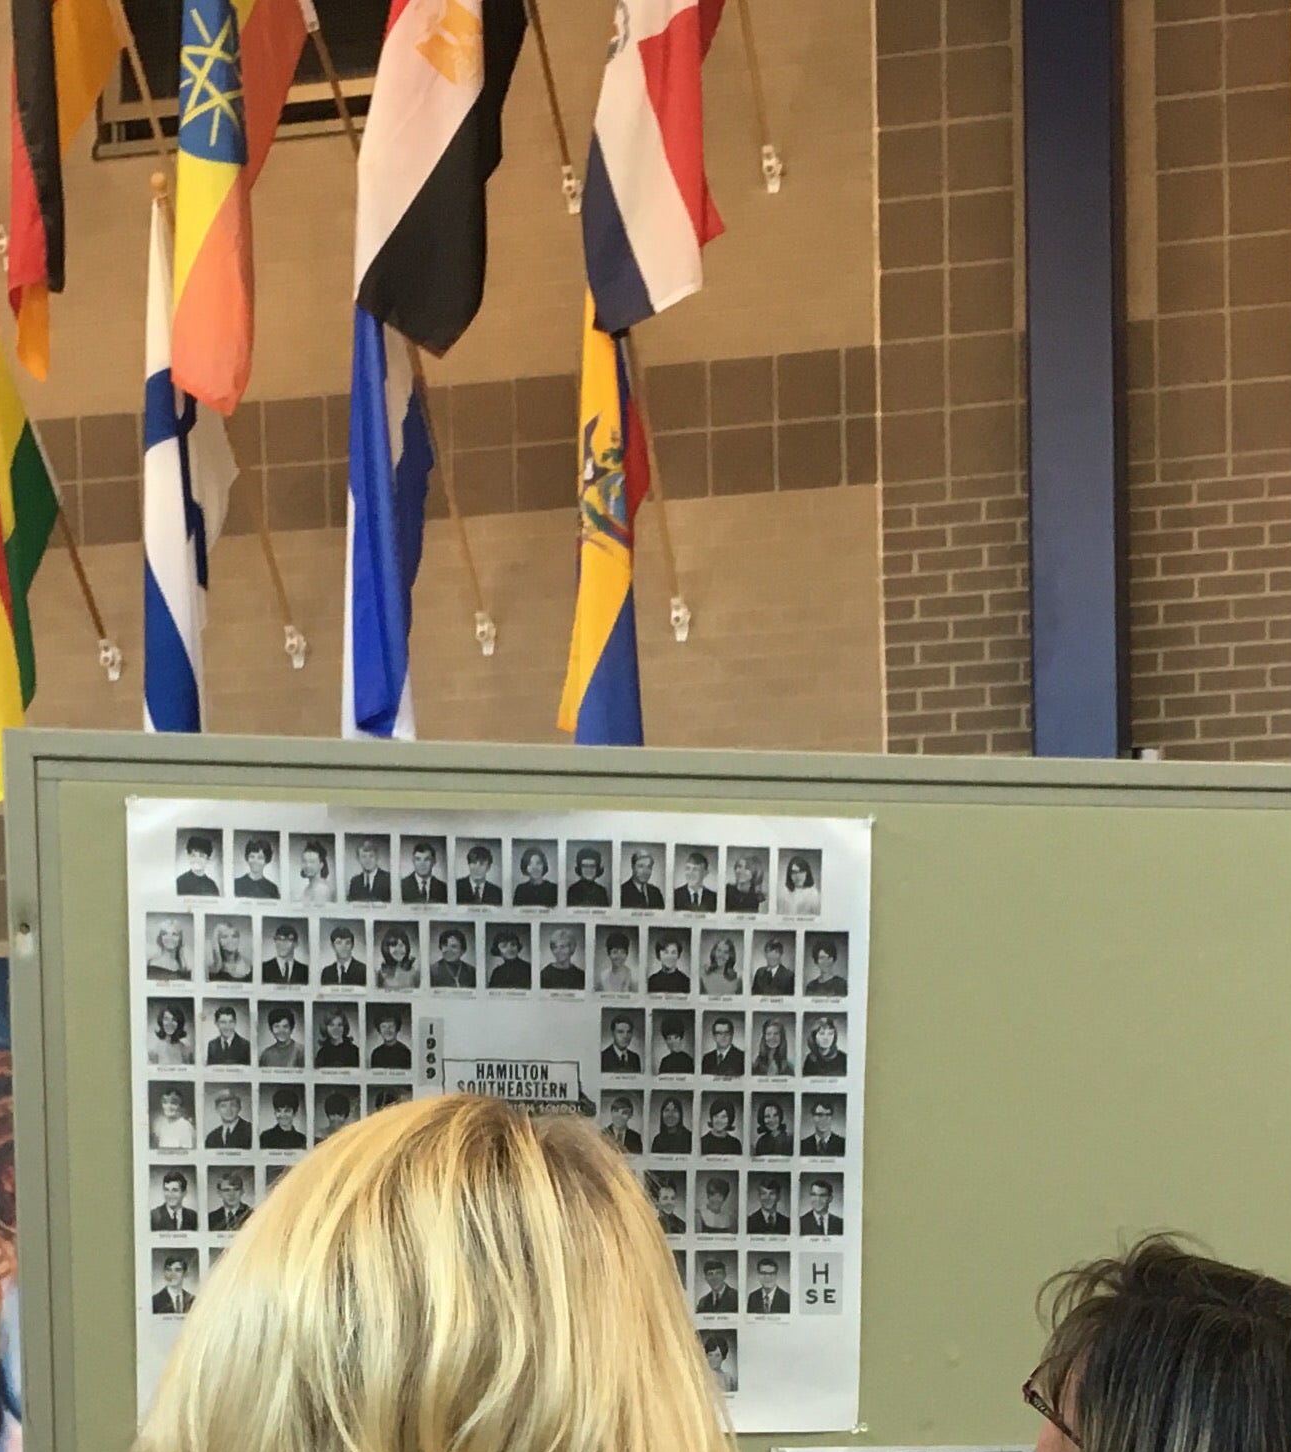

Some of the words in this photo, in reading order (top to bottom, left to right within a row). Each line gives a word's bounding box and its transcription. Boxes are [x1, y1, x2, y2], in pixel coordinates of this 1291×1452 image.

[426, 1023, 437, 1080] 1969
[476, 1063, 549, 1081] HAMILTON
[457, 1080, 567, 1099] SOUTHEASTERN
[812, 1262, 829, 1285] H
